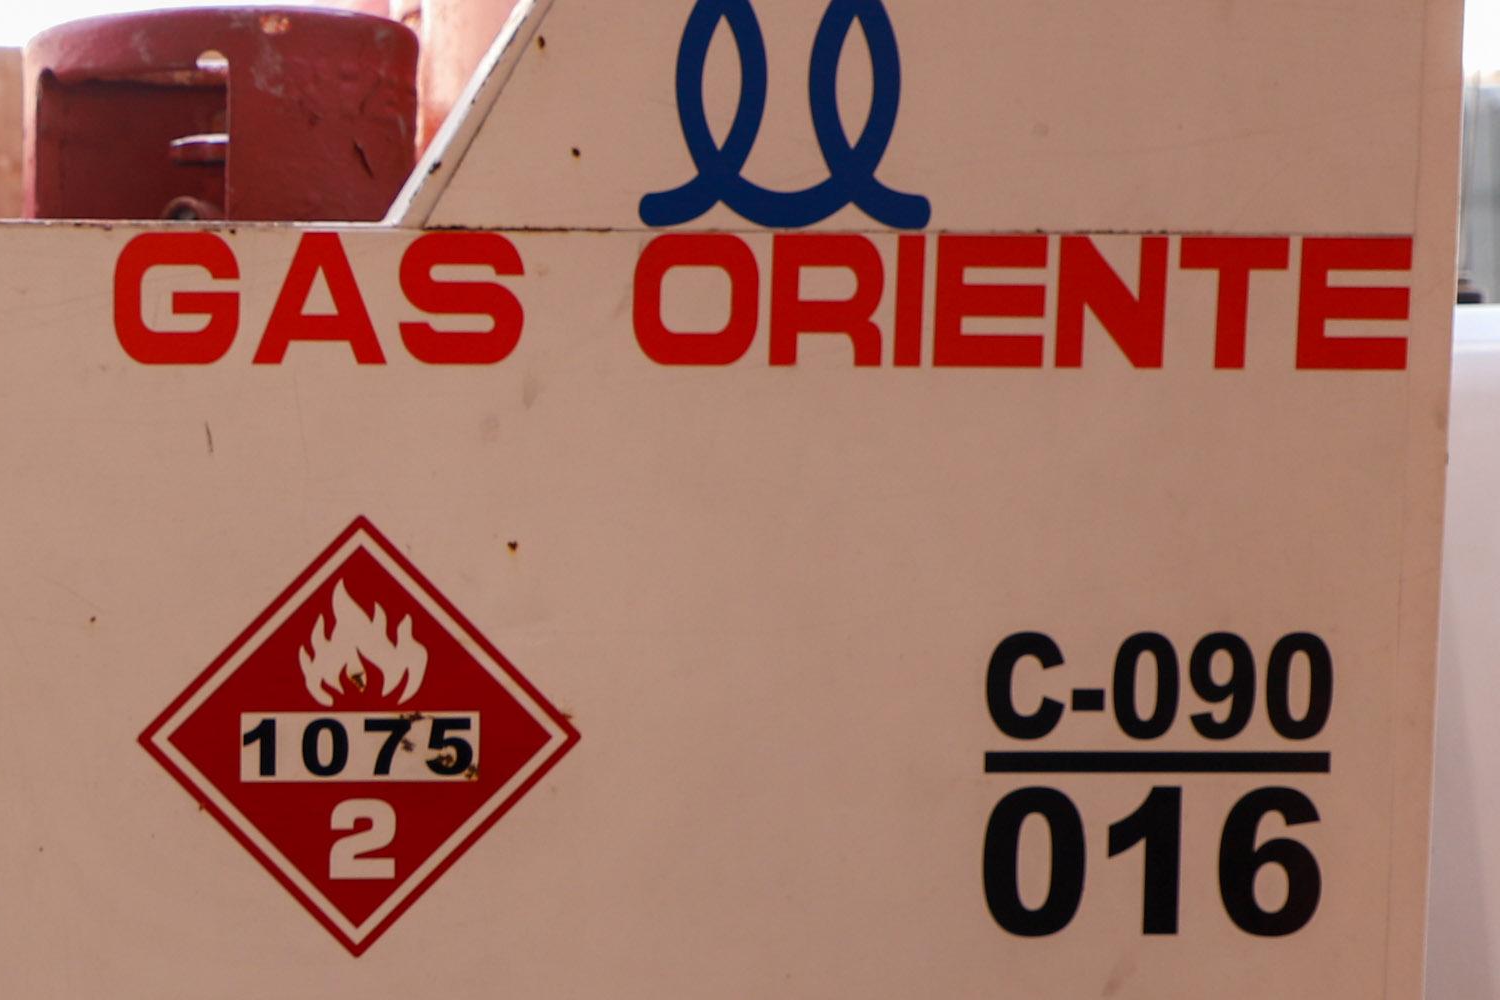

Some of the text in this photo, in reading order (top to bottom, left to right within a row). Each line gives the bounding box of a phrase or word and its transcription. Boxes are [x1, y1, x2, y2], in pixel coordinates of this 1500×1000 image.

[113, 229, 1414, 371] GAS ORIENTE
[986, 631, 1333, 740] C-090
[242, 717, 475, 777] 1075
[329, 798, 397, 879] 2
[982, 786, 1321, 938] 016
